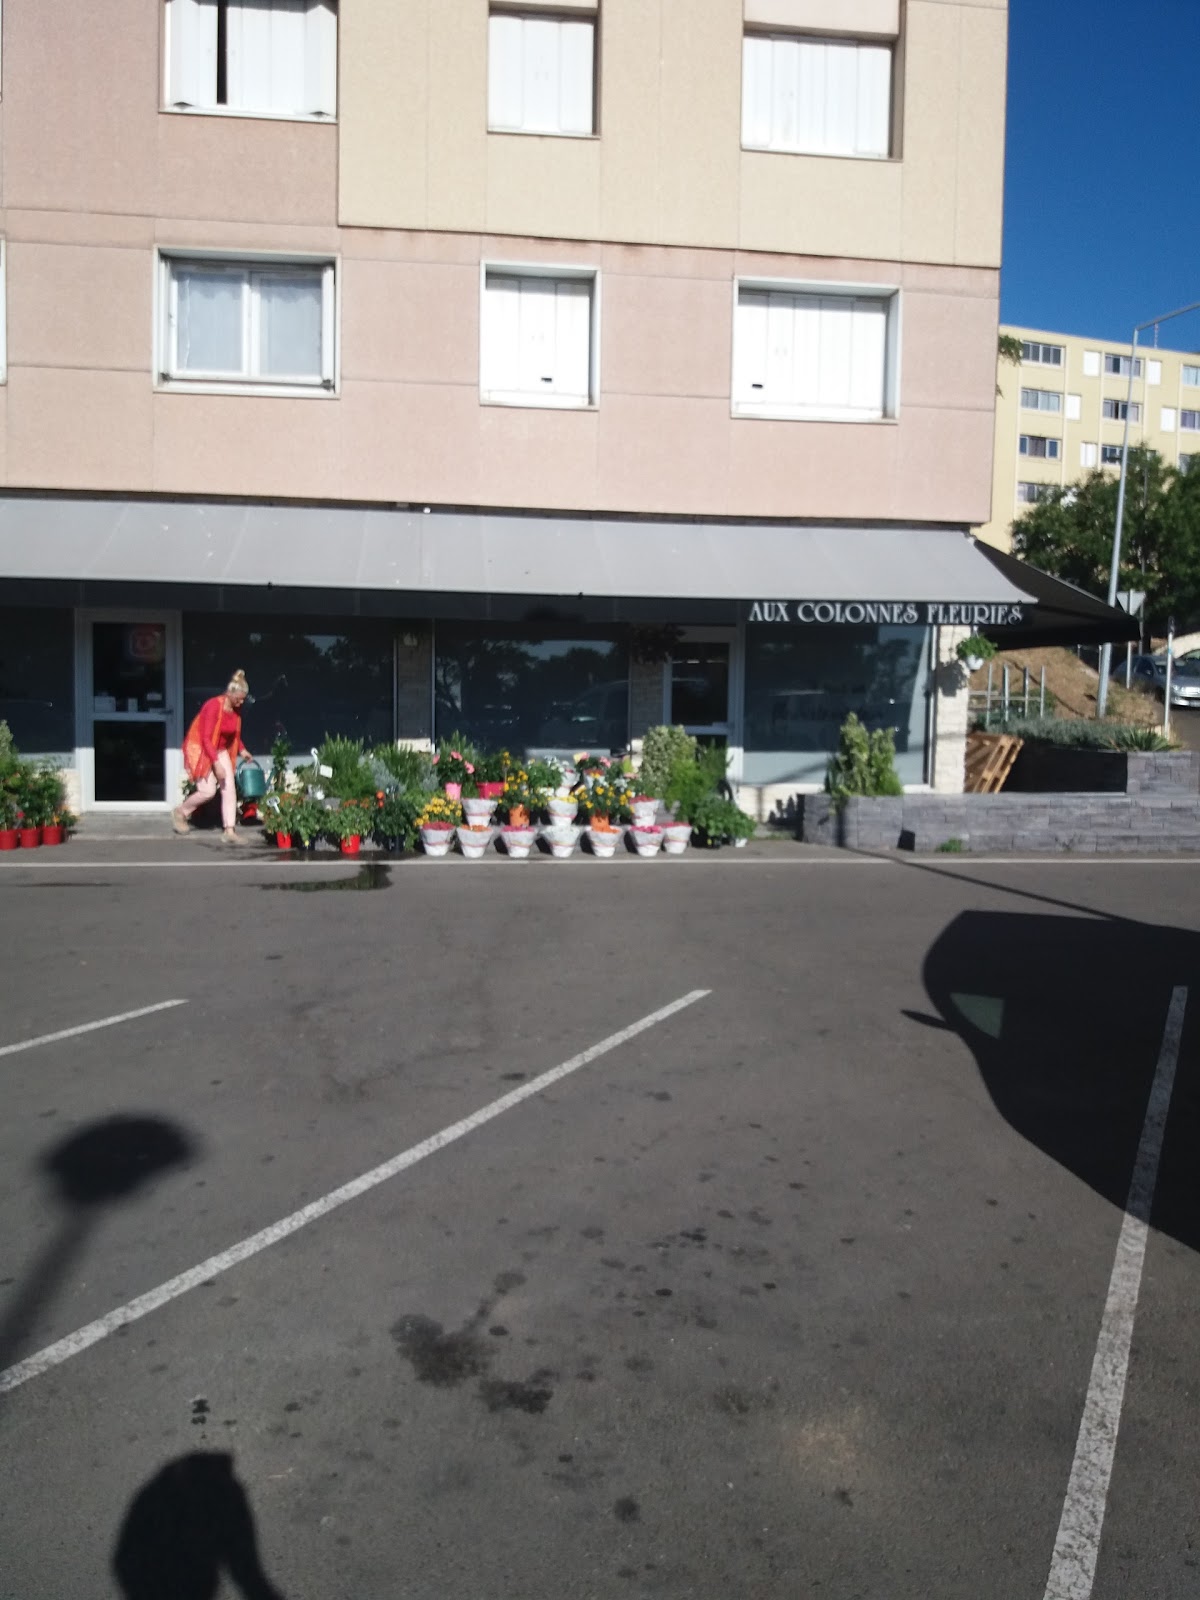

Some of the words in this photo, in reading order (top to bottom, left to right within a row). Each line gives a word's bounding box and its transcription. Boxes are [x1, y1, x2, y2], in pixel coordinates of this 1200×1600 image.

[748, 602, 790, 622] AUX
[797, 602, 919, 623] COLONNES
[926, 603, 1023, 625] FLEURIES
